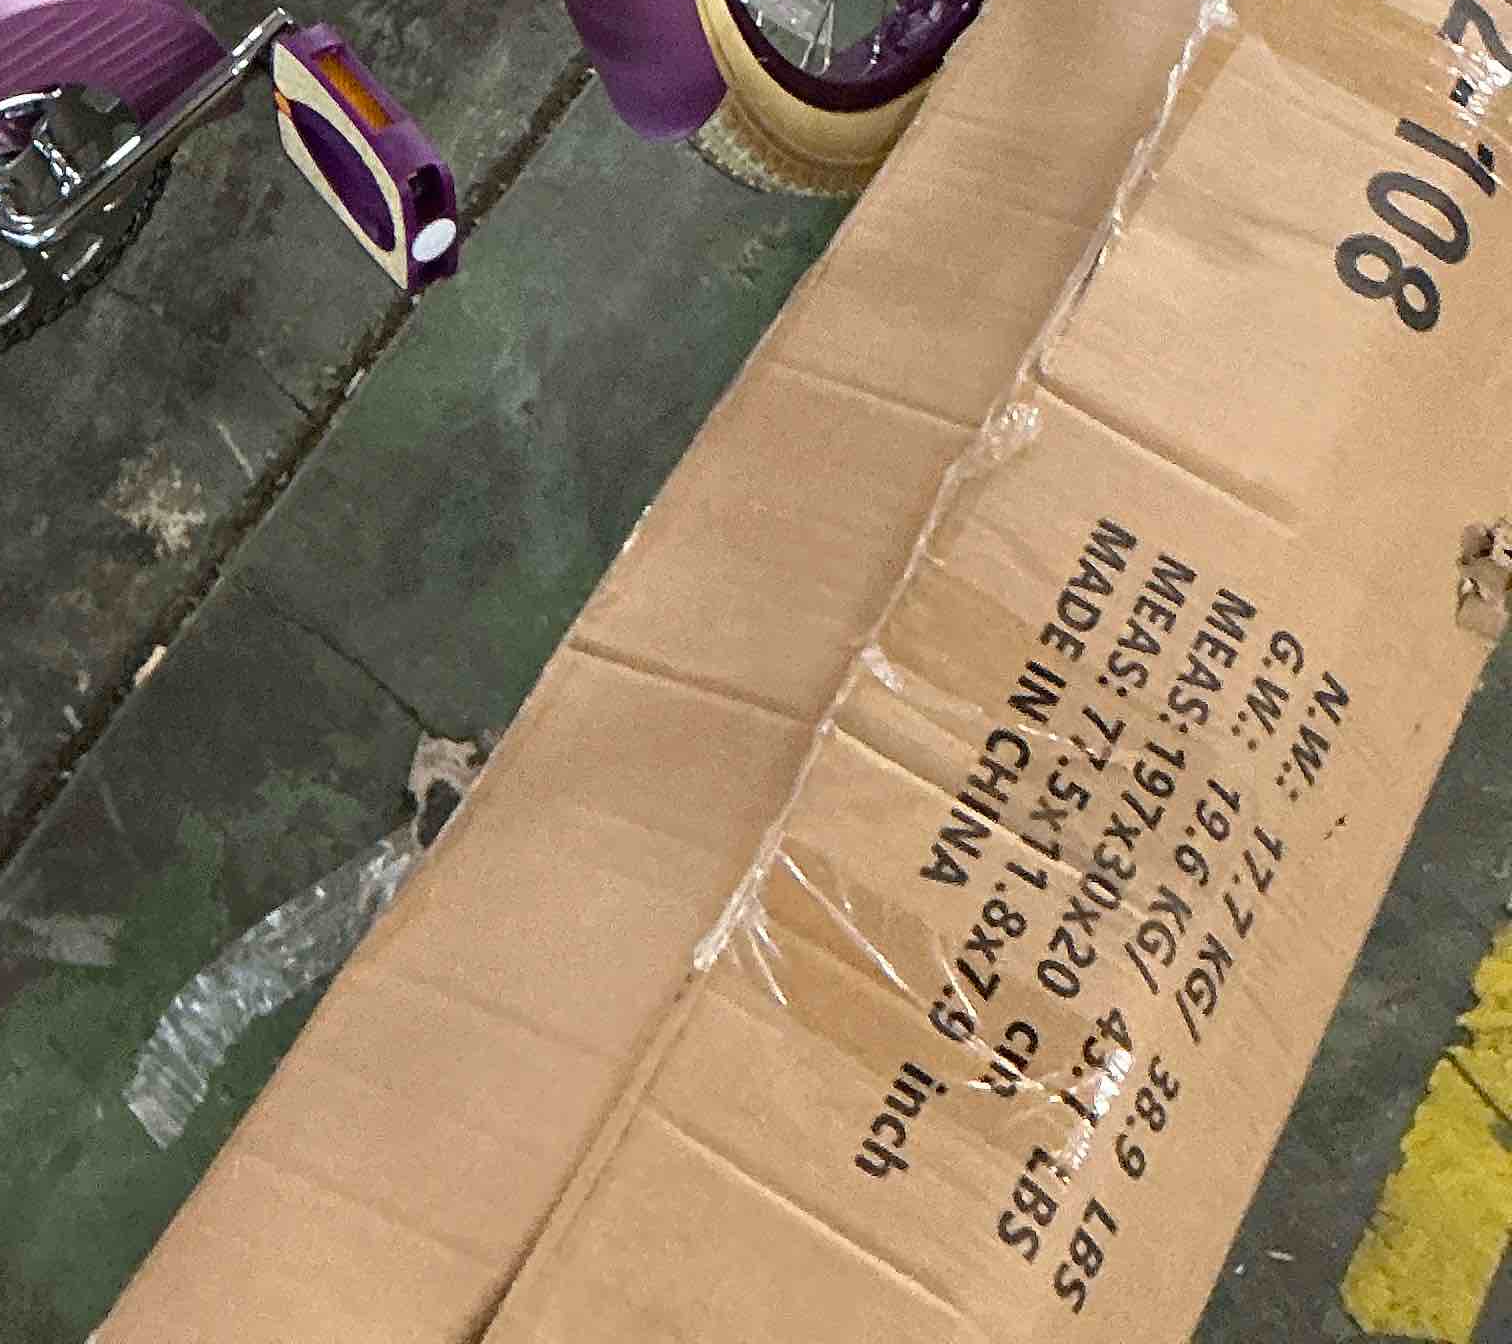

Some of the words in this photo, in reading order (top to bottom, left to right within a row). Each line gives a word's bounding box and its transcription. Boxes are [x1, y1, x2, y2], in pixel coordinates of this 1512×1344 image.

[1039, 518, 1138, 662] MADE
[1097, 553, 1197, 697] MEAS:
[1007, 659, 1067, 724] IN
[1231, 631, 1305, 751] G.W.:
[1276, 671, 1350, 801] N.W.:
[920, 727, 1031, 887] CHINA
[1174, 778, 1241, 887] 19.6
[1124, 885, 1193, 995] KG/
[1222, 825, 1286, 938] 17.7
[1175, 932, 1234, 1045] KG/
[854, 1062, 948, 1179] inch
[1115, 1055, 1180, 1180] 38.9
[998, 1145, 1071, 1264] LBS
[1053, 1197, 1119, 1314] LBS
